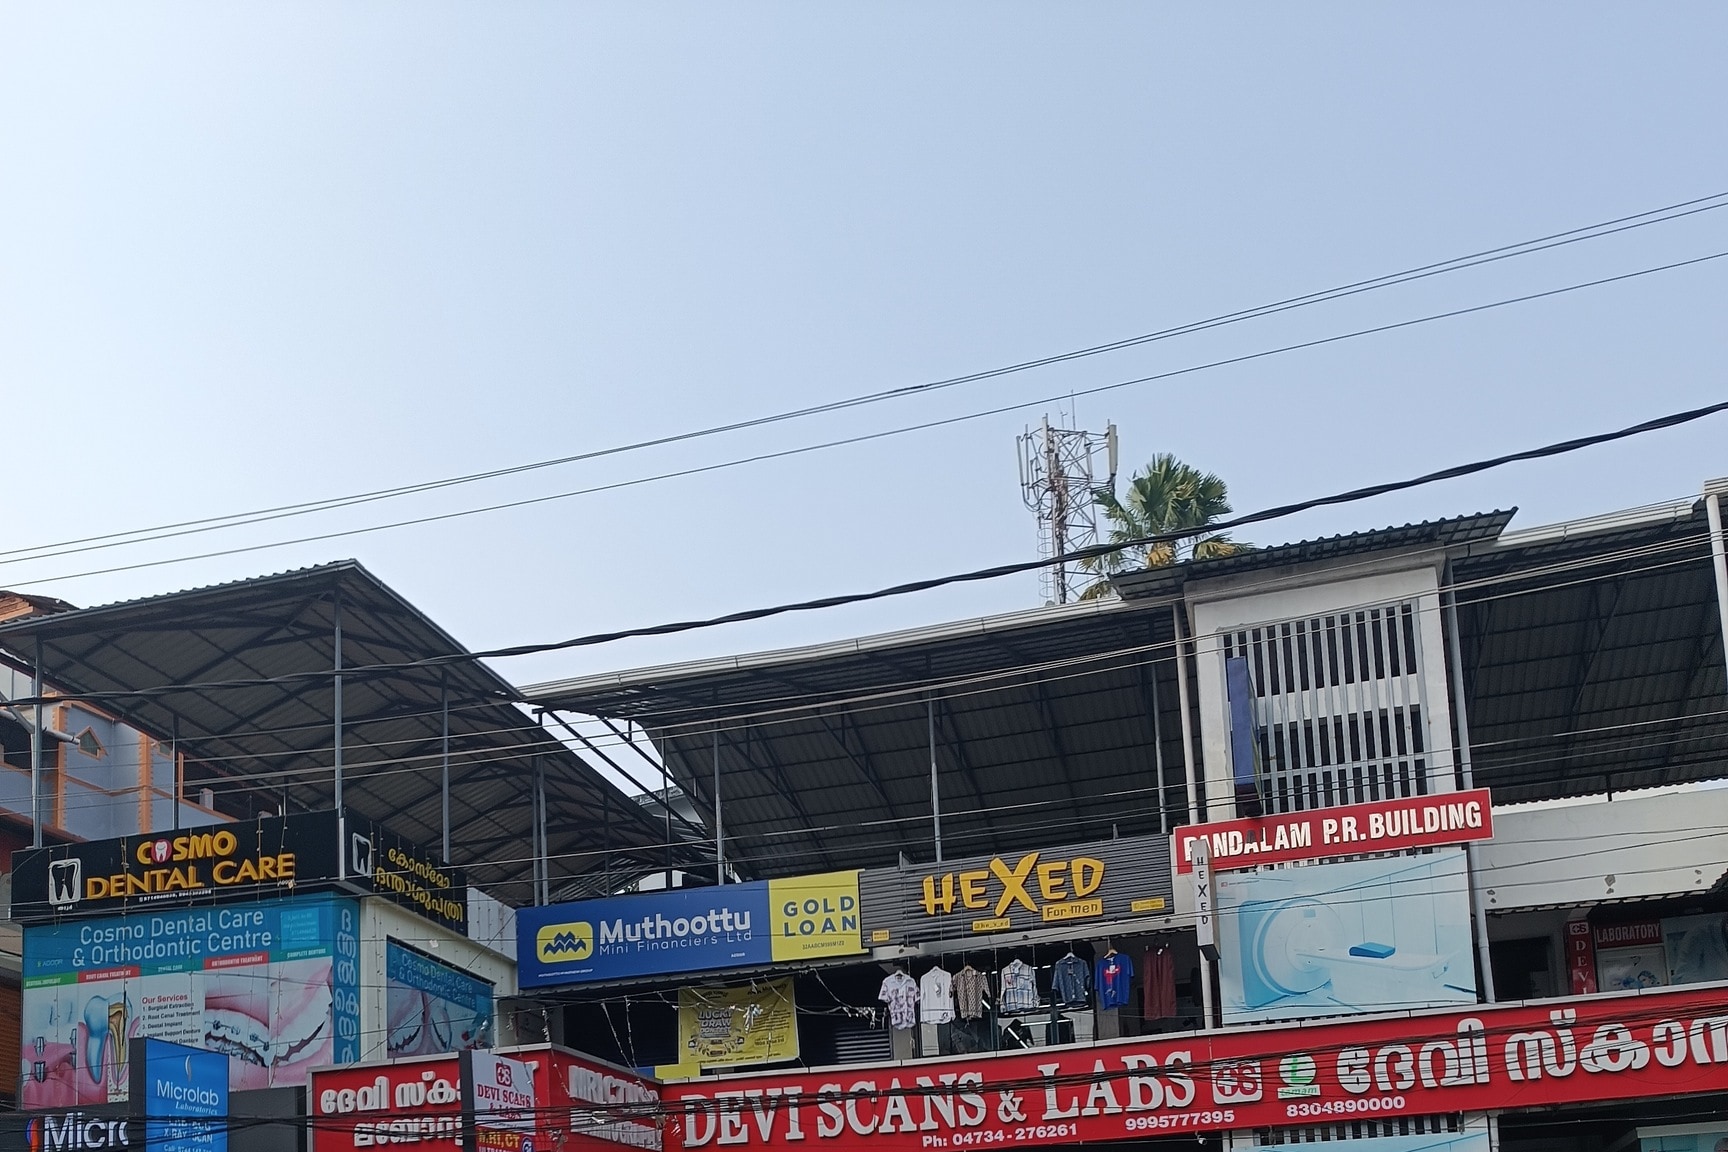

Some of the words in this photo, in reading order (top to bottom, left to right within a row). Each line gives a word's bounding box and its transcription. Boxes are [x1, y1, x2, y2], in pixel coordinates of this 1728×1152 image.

[86, 866, 205, 899] DENTAL
[212, 853, 296, 885] CARE
[919, 852, 1105, 917] HEXED
[1196, 856, 1209, 926] HEXED
[783, 895, 855, 917] GOLD
[1046, 906, 1067, 918] For
[80, 924, 145, 945] Cosmo
[151, 912, 213, 937] Dental
[219, 909, 264, 930] Care
[599, 907, 751, 945] Muthoottu
[784, 915, 856, 937] LOAN
[1596, 923, 1660, 943] LABORATORY
[72, 948, 86, 967] &
[92, 936, 201, 965] Orthodontic
[208, 930, 272, 952] Centre
[600, 944, 629, 956] Mini
[638, 936, 718, 953] Financiers
[727, 930, 752, 943] Ltd
[402, 953, 430, 976] Cosmo
[142, 996, 156, 1004] Our
[158, 994, 188, 1002] Services
[1336, 1017, 1490, 1094] ദേവി
[157, 1079, 219, 1107] Microlab
[320, 1076, 390, 1114] ദേവി
[395, 1071, 462, 1108] സ്ക
[477, 1084, 500, 1102] DEVI
[502, 1088, 531, 1110] SCANS
[680, 1086, 804, 1148] DEVI
[816, 1071, 987, 1139] SCANS
[997, 1086, 1027, 1122] &
[1037, 1050, 1196, 1121] LABS
[1286, 1096, 1405, 1117] 8304890000
[175, 1101, 218, 1116] Laboratories
[922, 1134, 947, 1148] Ph:
[1125, 1110, 1235, 1131] 9995777395
